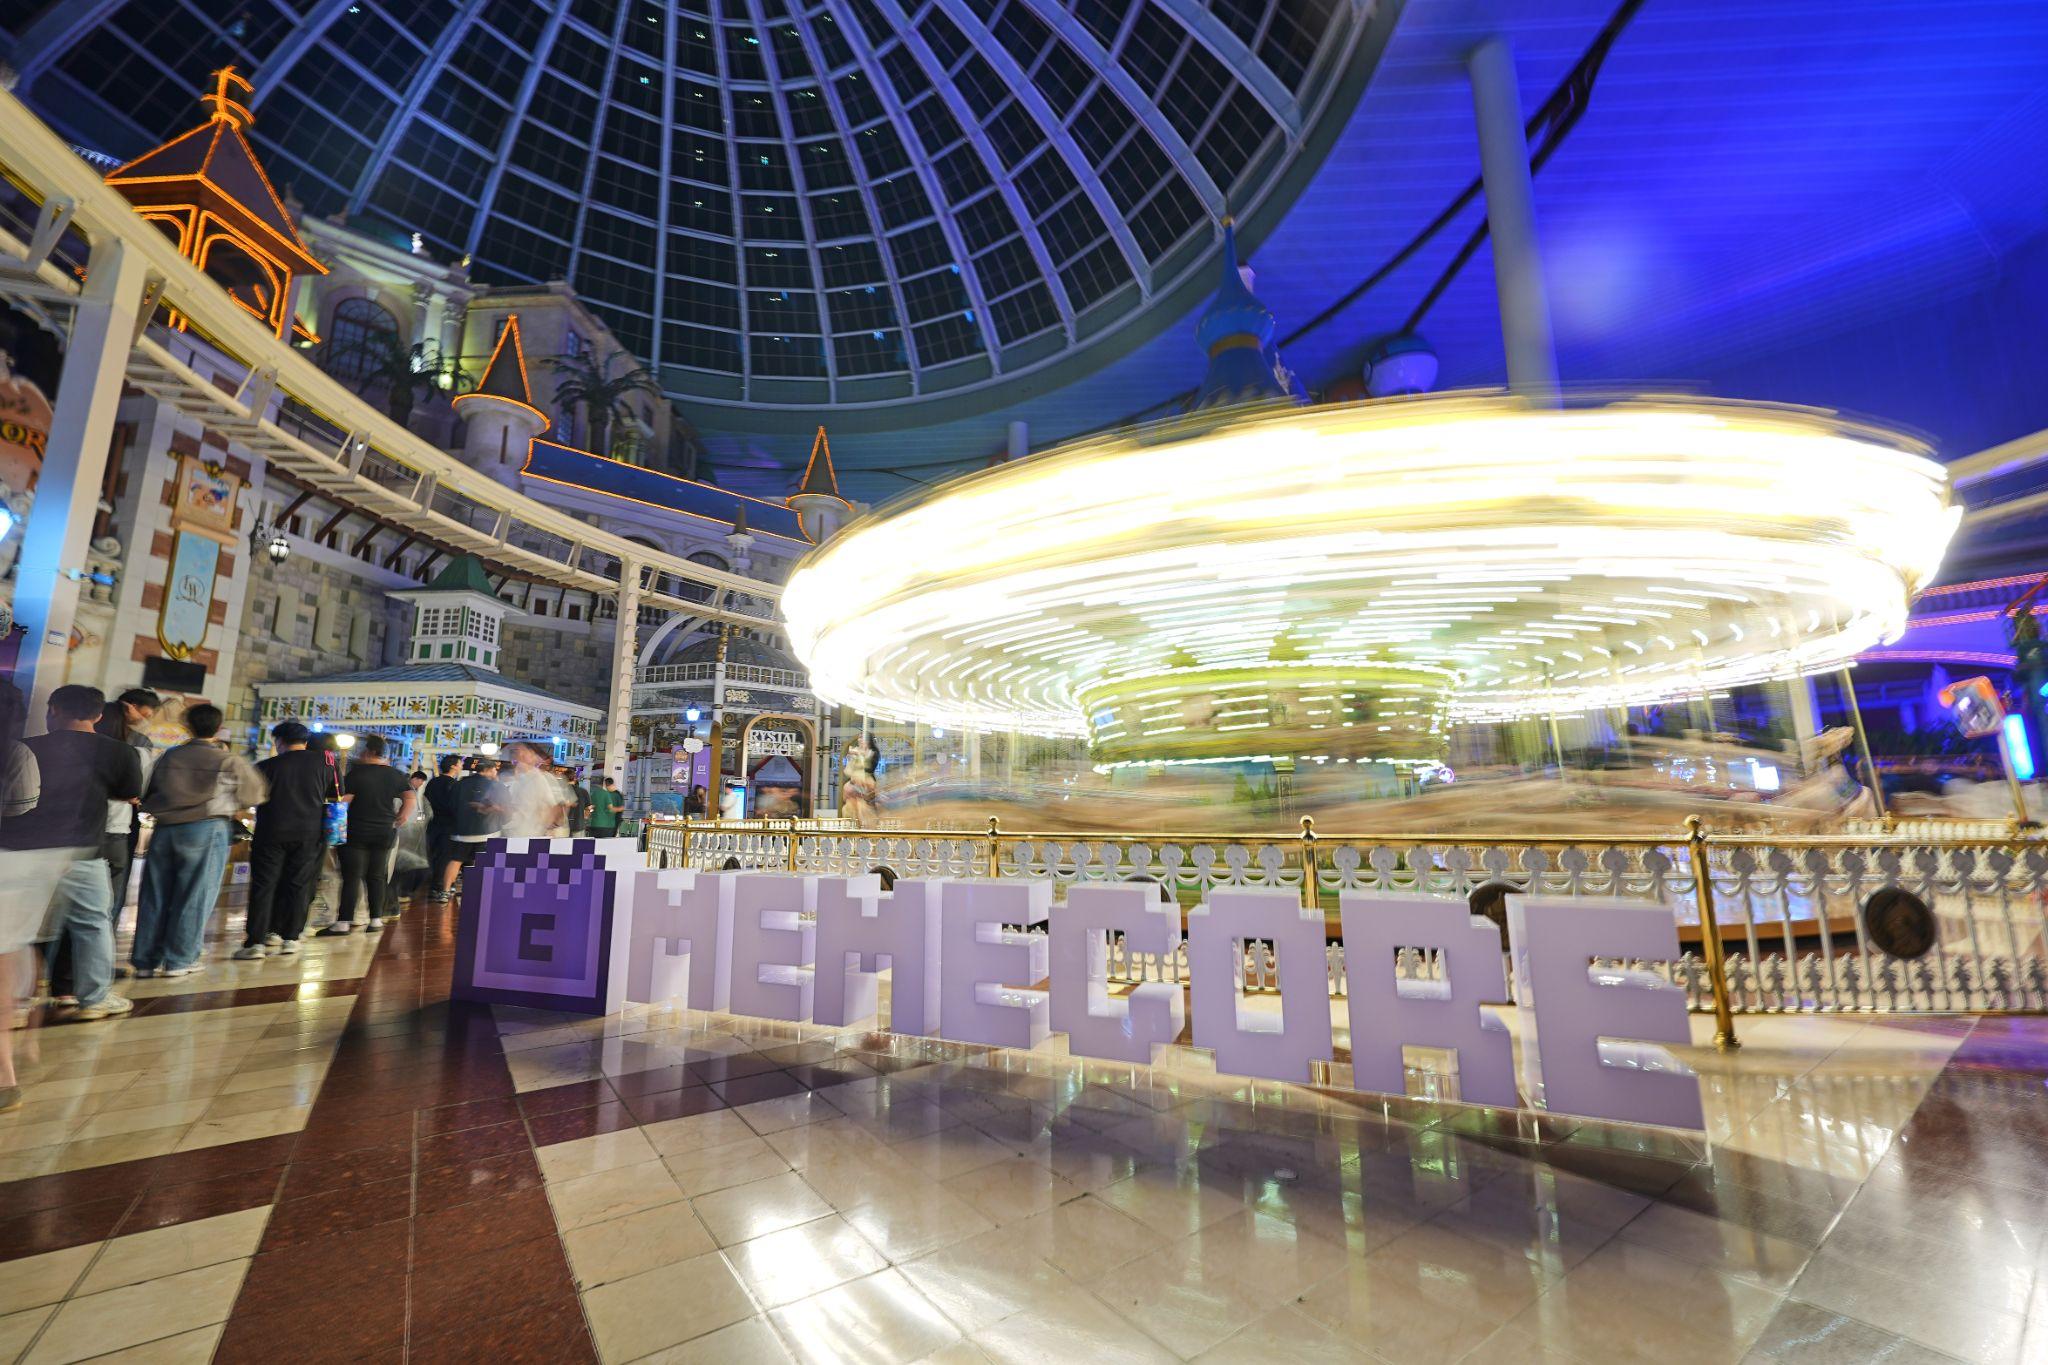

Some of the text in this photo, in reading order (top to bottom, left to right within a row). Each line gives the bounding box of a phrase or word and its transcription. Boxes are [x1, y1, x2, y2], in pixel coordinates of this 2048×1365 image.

[748, 729, 797, 744] RYSTAL
[749, 742, 796, 756] ALACE
[625, 870, 1705, 1131] MEMECORE
